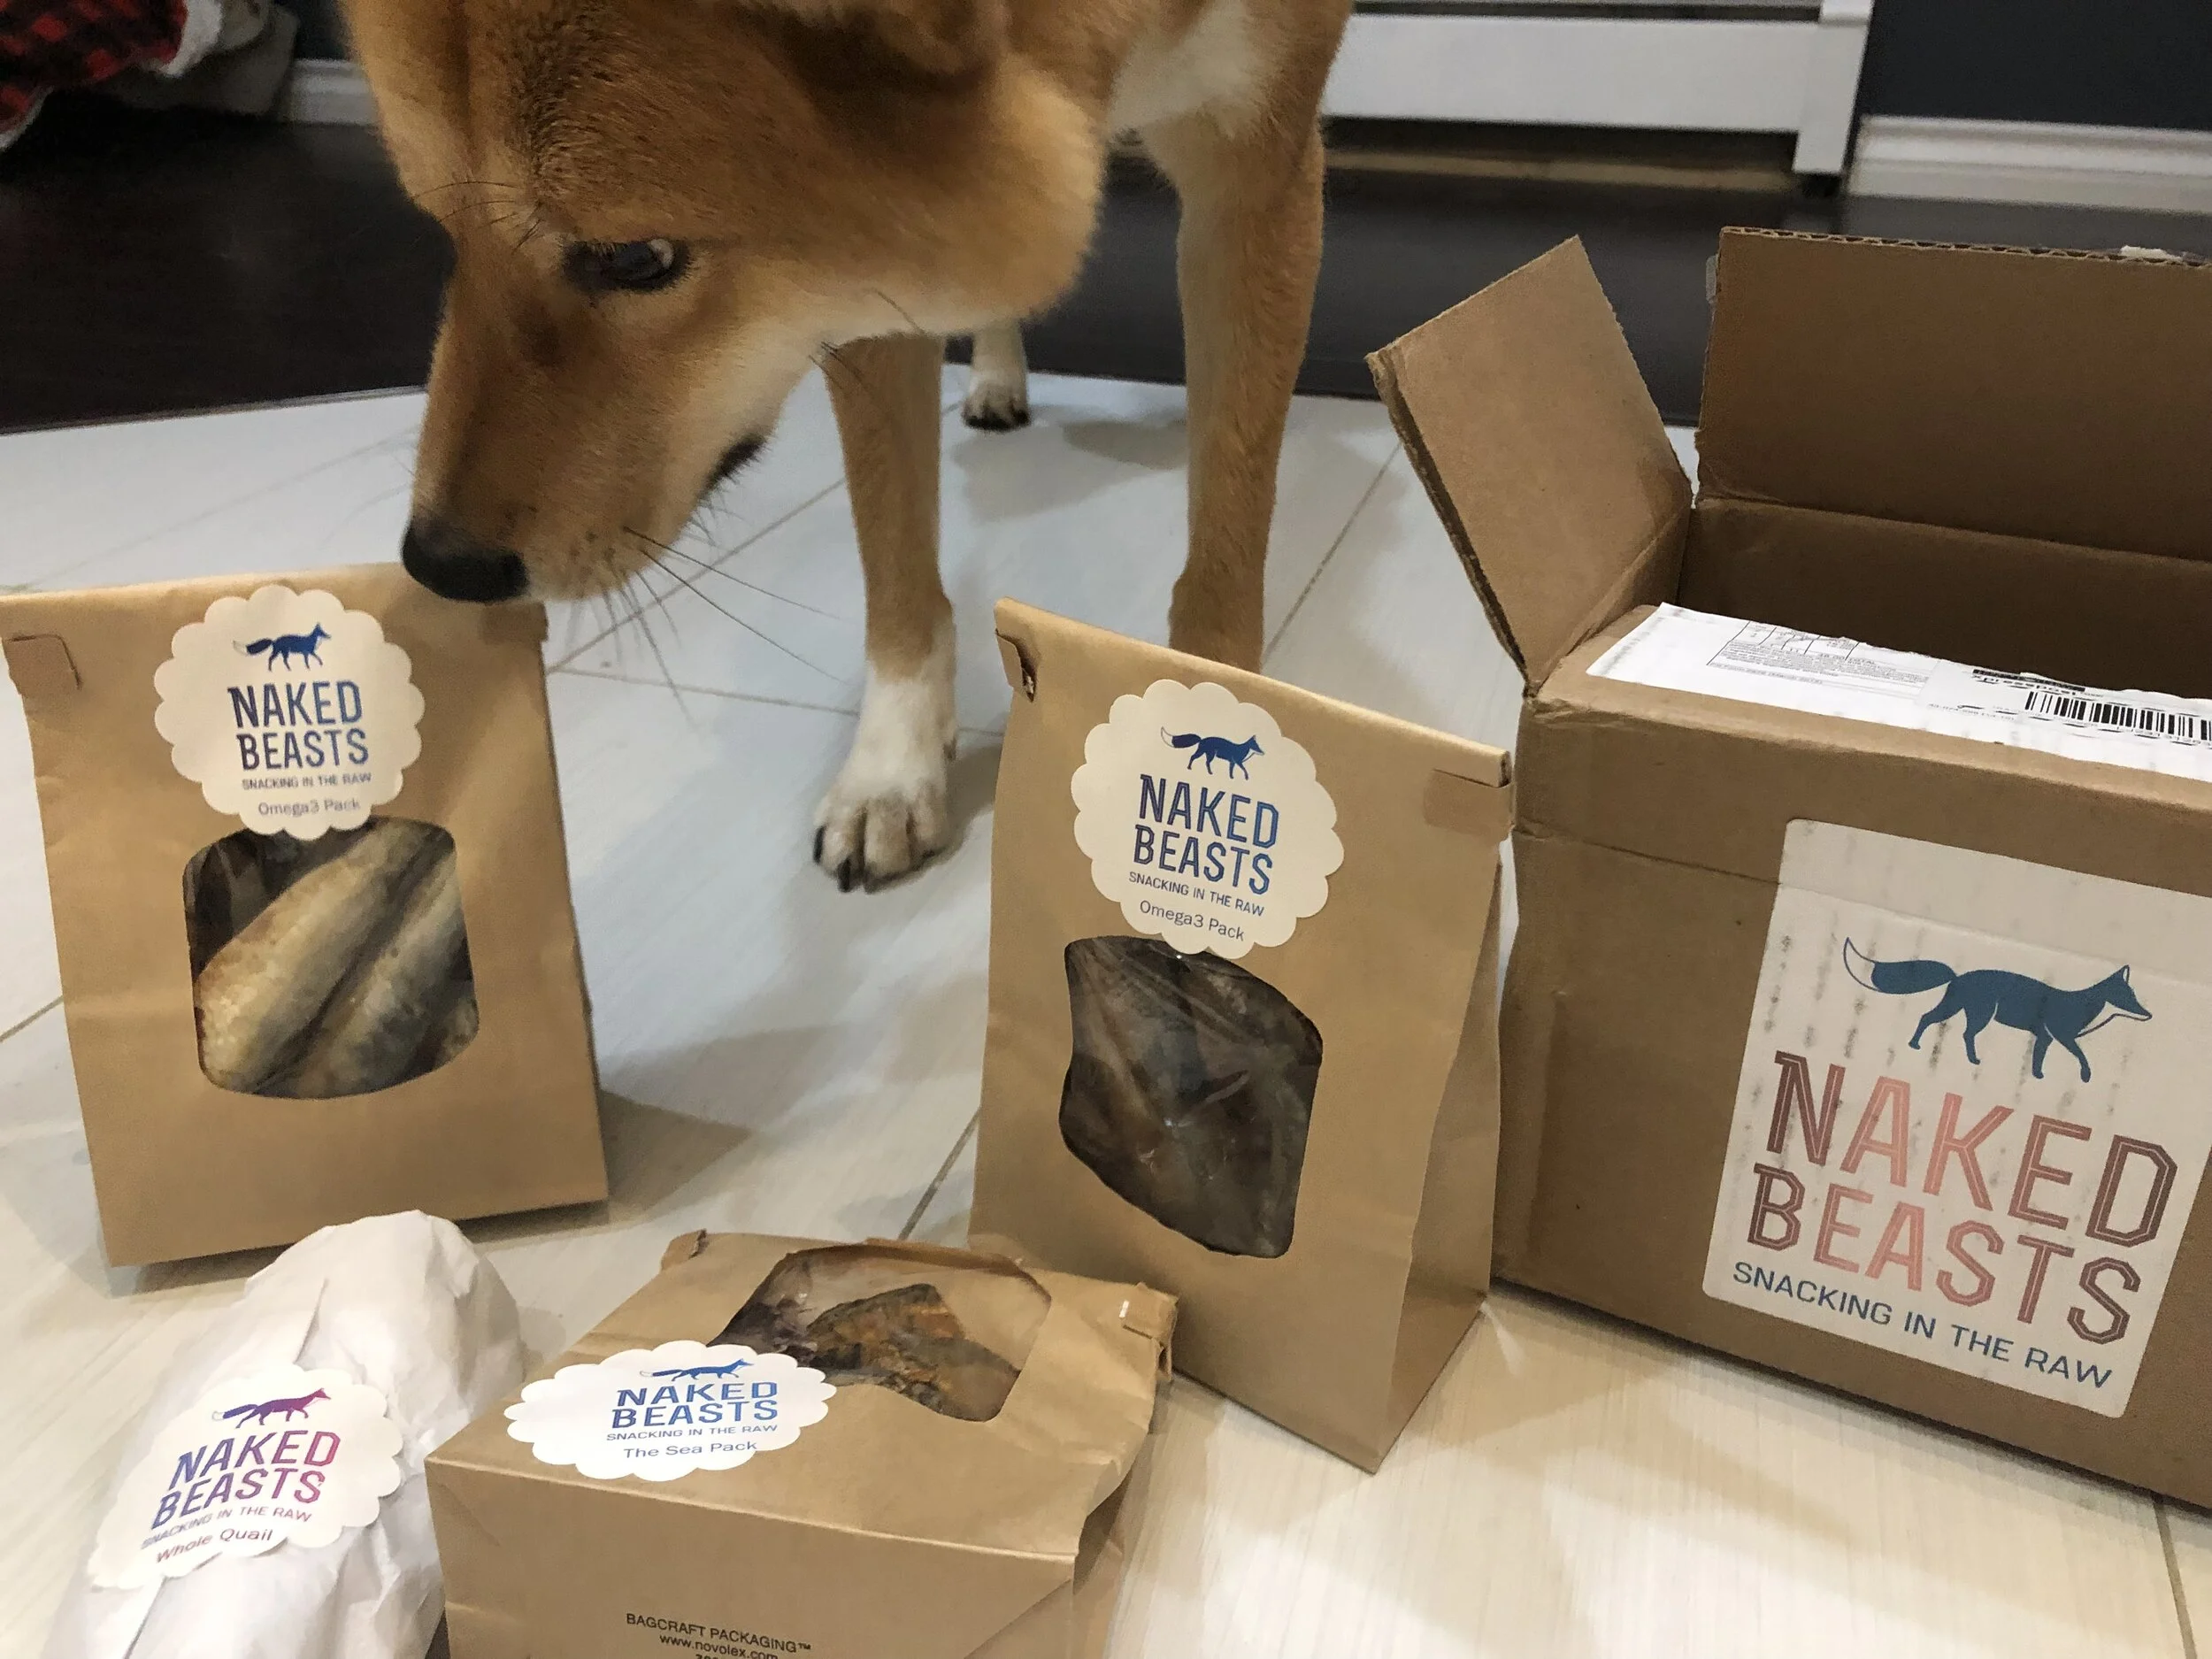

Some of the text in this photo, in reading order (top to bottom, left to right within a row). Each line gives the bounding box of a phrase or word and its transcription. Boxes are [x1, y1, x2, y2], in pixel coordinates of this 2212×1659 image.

[227, 680, 363, 728] NAKED
[236, 728, 369, 771] BEASTS
[242, 772, 372, 790] SNACKING IN THE RAW
[258, 798, 361, 817] Omega3 Pack
[1139, 774, 1279, 849] NAKED
[1133, 824, 1272, 895] BEASTS
[1128, 872, 1264, 917] SNACKING IN THE RAW
[1140, 900, 1245, 941] Omega3 Pack
[1766, 1050, 2177, 1248] NAKED
[1747, 1163, 2141, 1345] BEASTS
[1732, 1261, 2113, 1389] SNACKING IN THE RAW
[611, 1400, 778, 1429] BEASTS
[617, 1381, 778, 1407] NAKED
[606, 1430, 683, 1441] SNACKING
[710, 1426, 736, 1435] THE
[624, 1441, 757, 1459] The Sea Pack
[169, 1430, 341, 1491] NAKED
[151, 1468, 326, 1530] BEASTS
[217, 1509, 233, 1519] IN
[240, 1506, 269, 1516] THE
[273, 1507, 312, 1522] RAW
[157, 1528, 273, 1563] Whole Quail
[626, 1613, 706, 1637] BAGCRAFT
[660, 1635, 779, 1659] www.novolex.com
